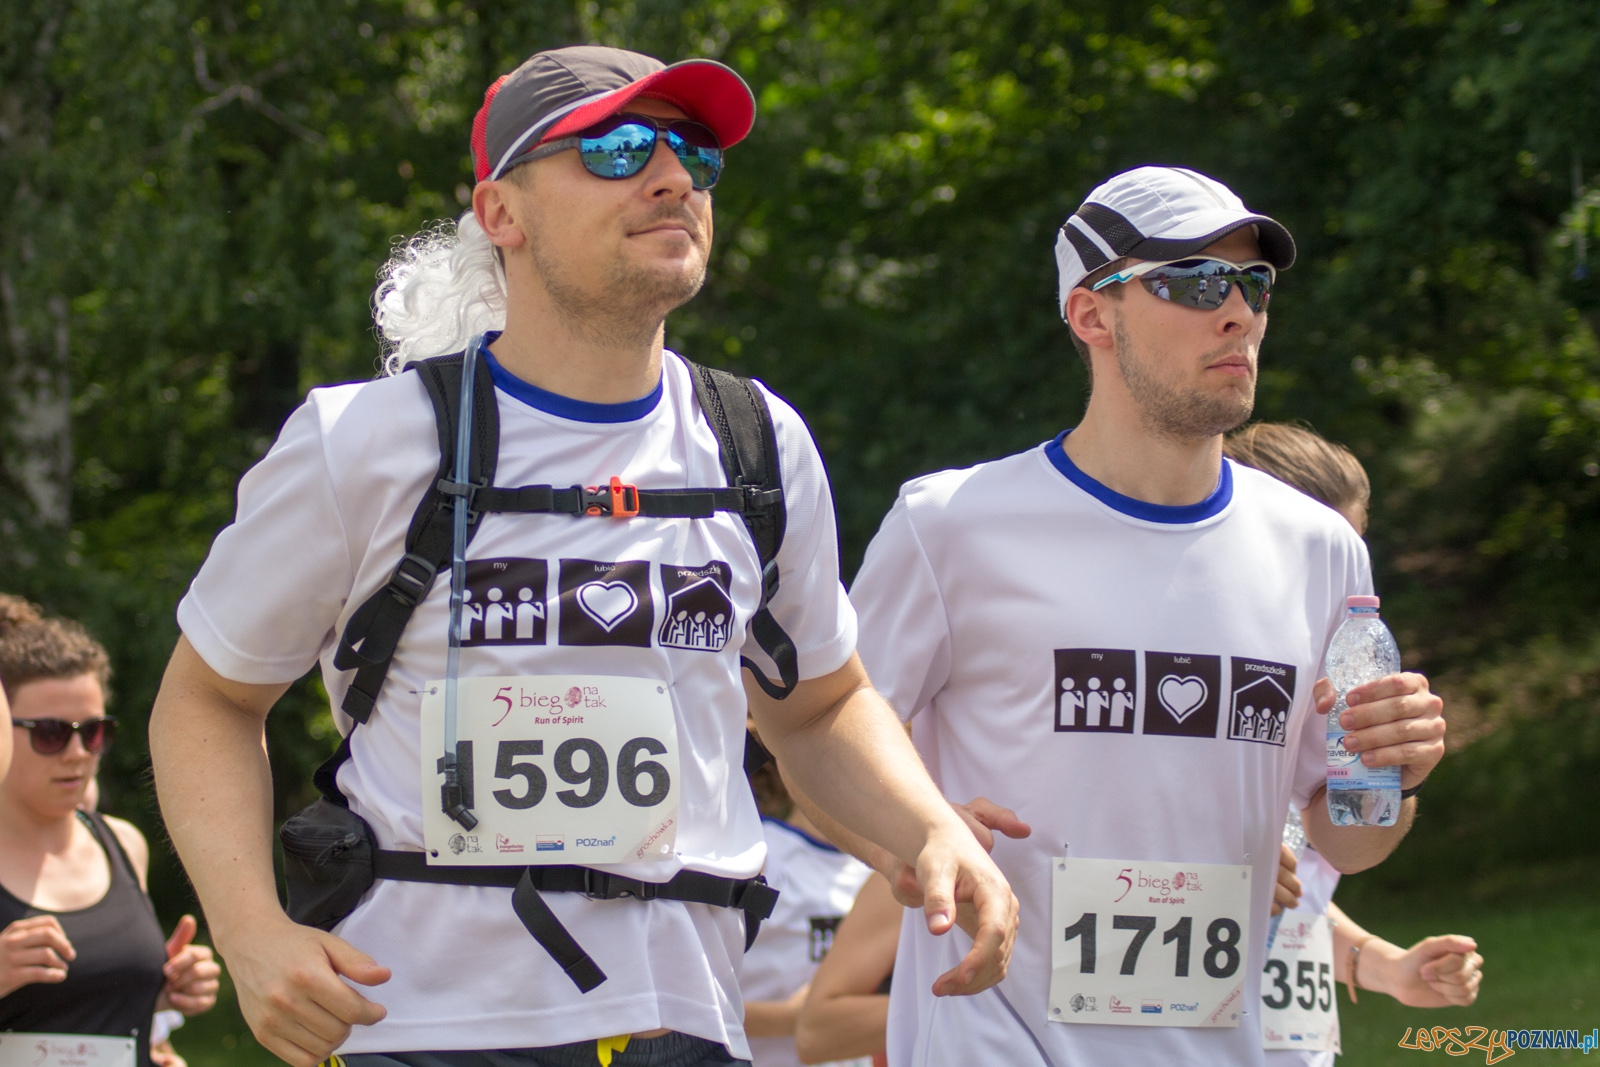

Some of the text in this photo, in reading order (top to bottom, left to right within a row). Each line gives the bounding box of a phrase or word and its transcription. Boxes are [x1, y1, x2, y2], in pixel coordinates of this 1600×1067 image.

[493, 561, 508, 572] my
[1091, 652, 1104, 661] my
[1173, 656, 1192, 665] lubić
[1245, 663, 1286, 676] przedszkole
[583, 686, 599, 696] na
[492, 686, 563, 726] 5 bieg
[584, 697, 607, 709] tak
[534, 715, 584, 726] Run of Spirit
[437, 737, 671, 809] 1596
[466, 835, 479, 843] na
[466, 843, 484, 854] tak
[1186, 871, 1199, 880] na
[1114, 868, 1171, 903] 5 bieg
[1186, 880, 1203, 892] tak
[1148, 896, 1186, 905] Run of Spirit
[1065, 913, 1242, 978] 1718
[1261, 959, 1332, 1012] 355
[1085, 1002, 1099, 1012] tak
